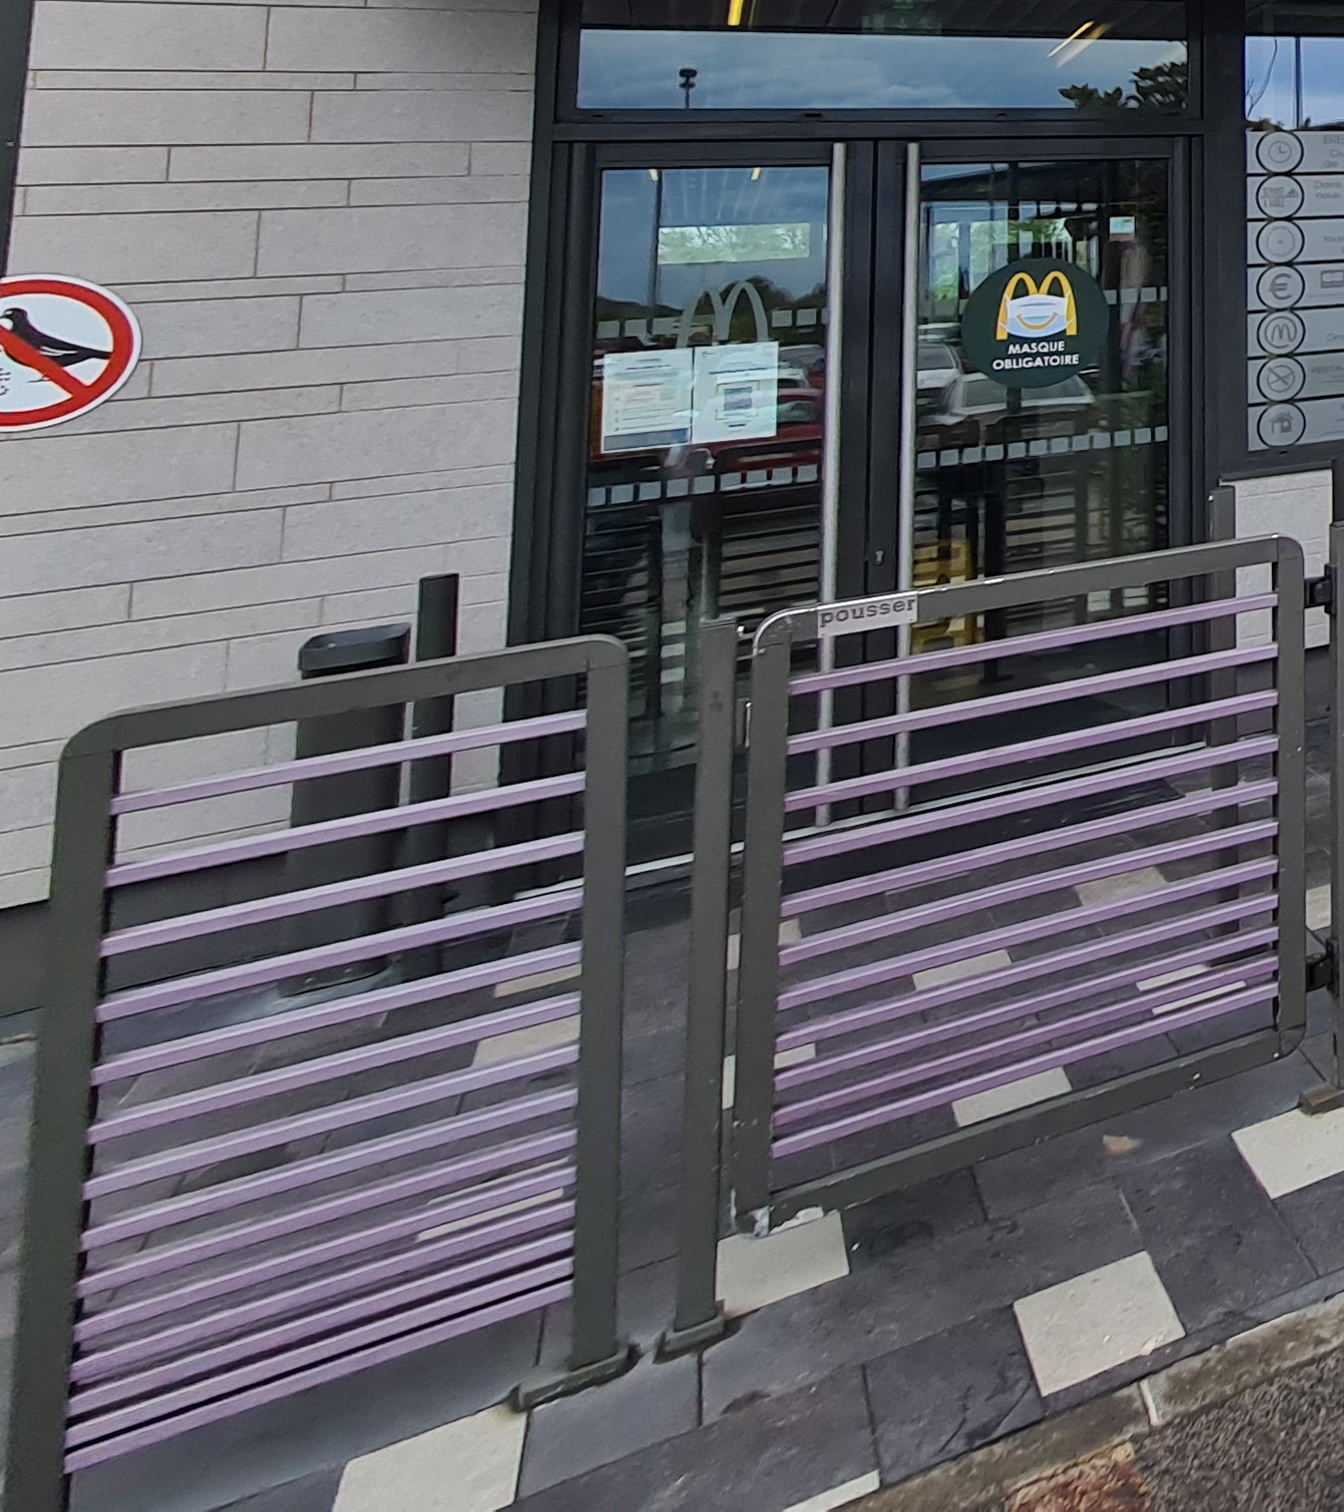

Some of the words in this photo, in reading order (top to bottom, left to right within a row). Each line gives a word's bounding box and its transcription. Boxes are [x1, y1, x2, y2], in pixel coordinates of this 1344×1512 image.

[1007, 340, 1065, 355] MASQUE
[992, 354, 1080, 370] OBLIGATOIRE
[820, 598, 916, 628] pousser
